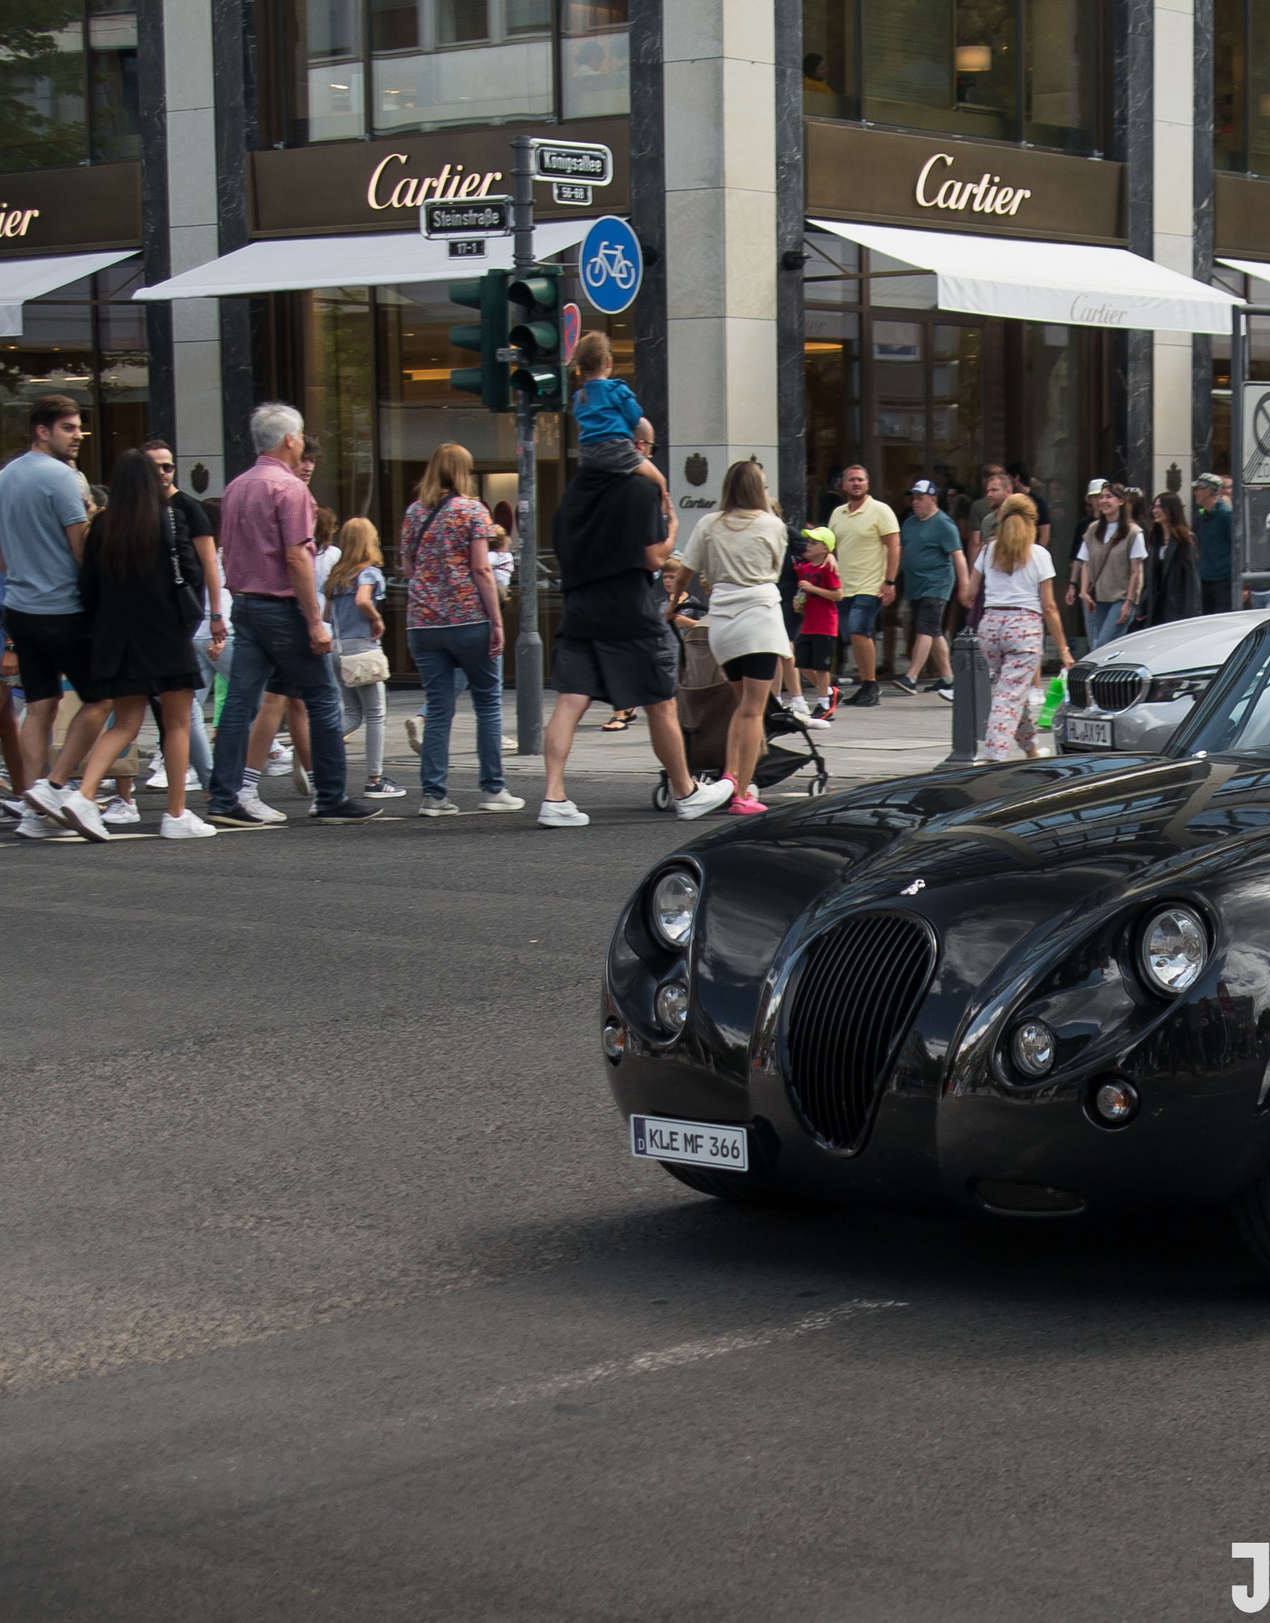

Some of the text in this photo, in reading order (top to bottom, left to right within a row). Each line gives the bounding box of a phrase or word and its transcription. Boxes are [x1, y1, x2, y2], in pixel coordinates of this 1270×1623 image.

[543, 151, 603, 174] Königsallee
[915, 153, 1032, 216] Cartier
[433, 208, 500, 229] Steinstraße
[1069, 293, 1128, 326] Cartier
[680, 495, 718, 509] Cartier
[649, 1128, 680, 1152] KLE
[683, 1132, 704, 1154] MF
[709, 1136, 740, 1160] 366
